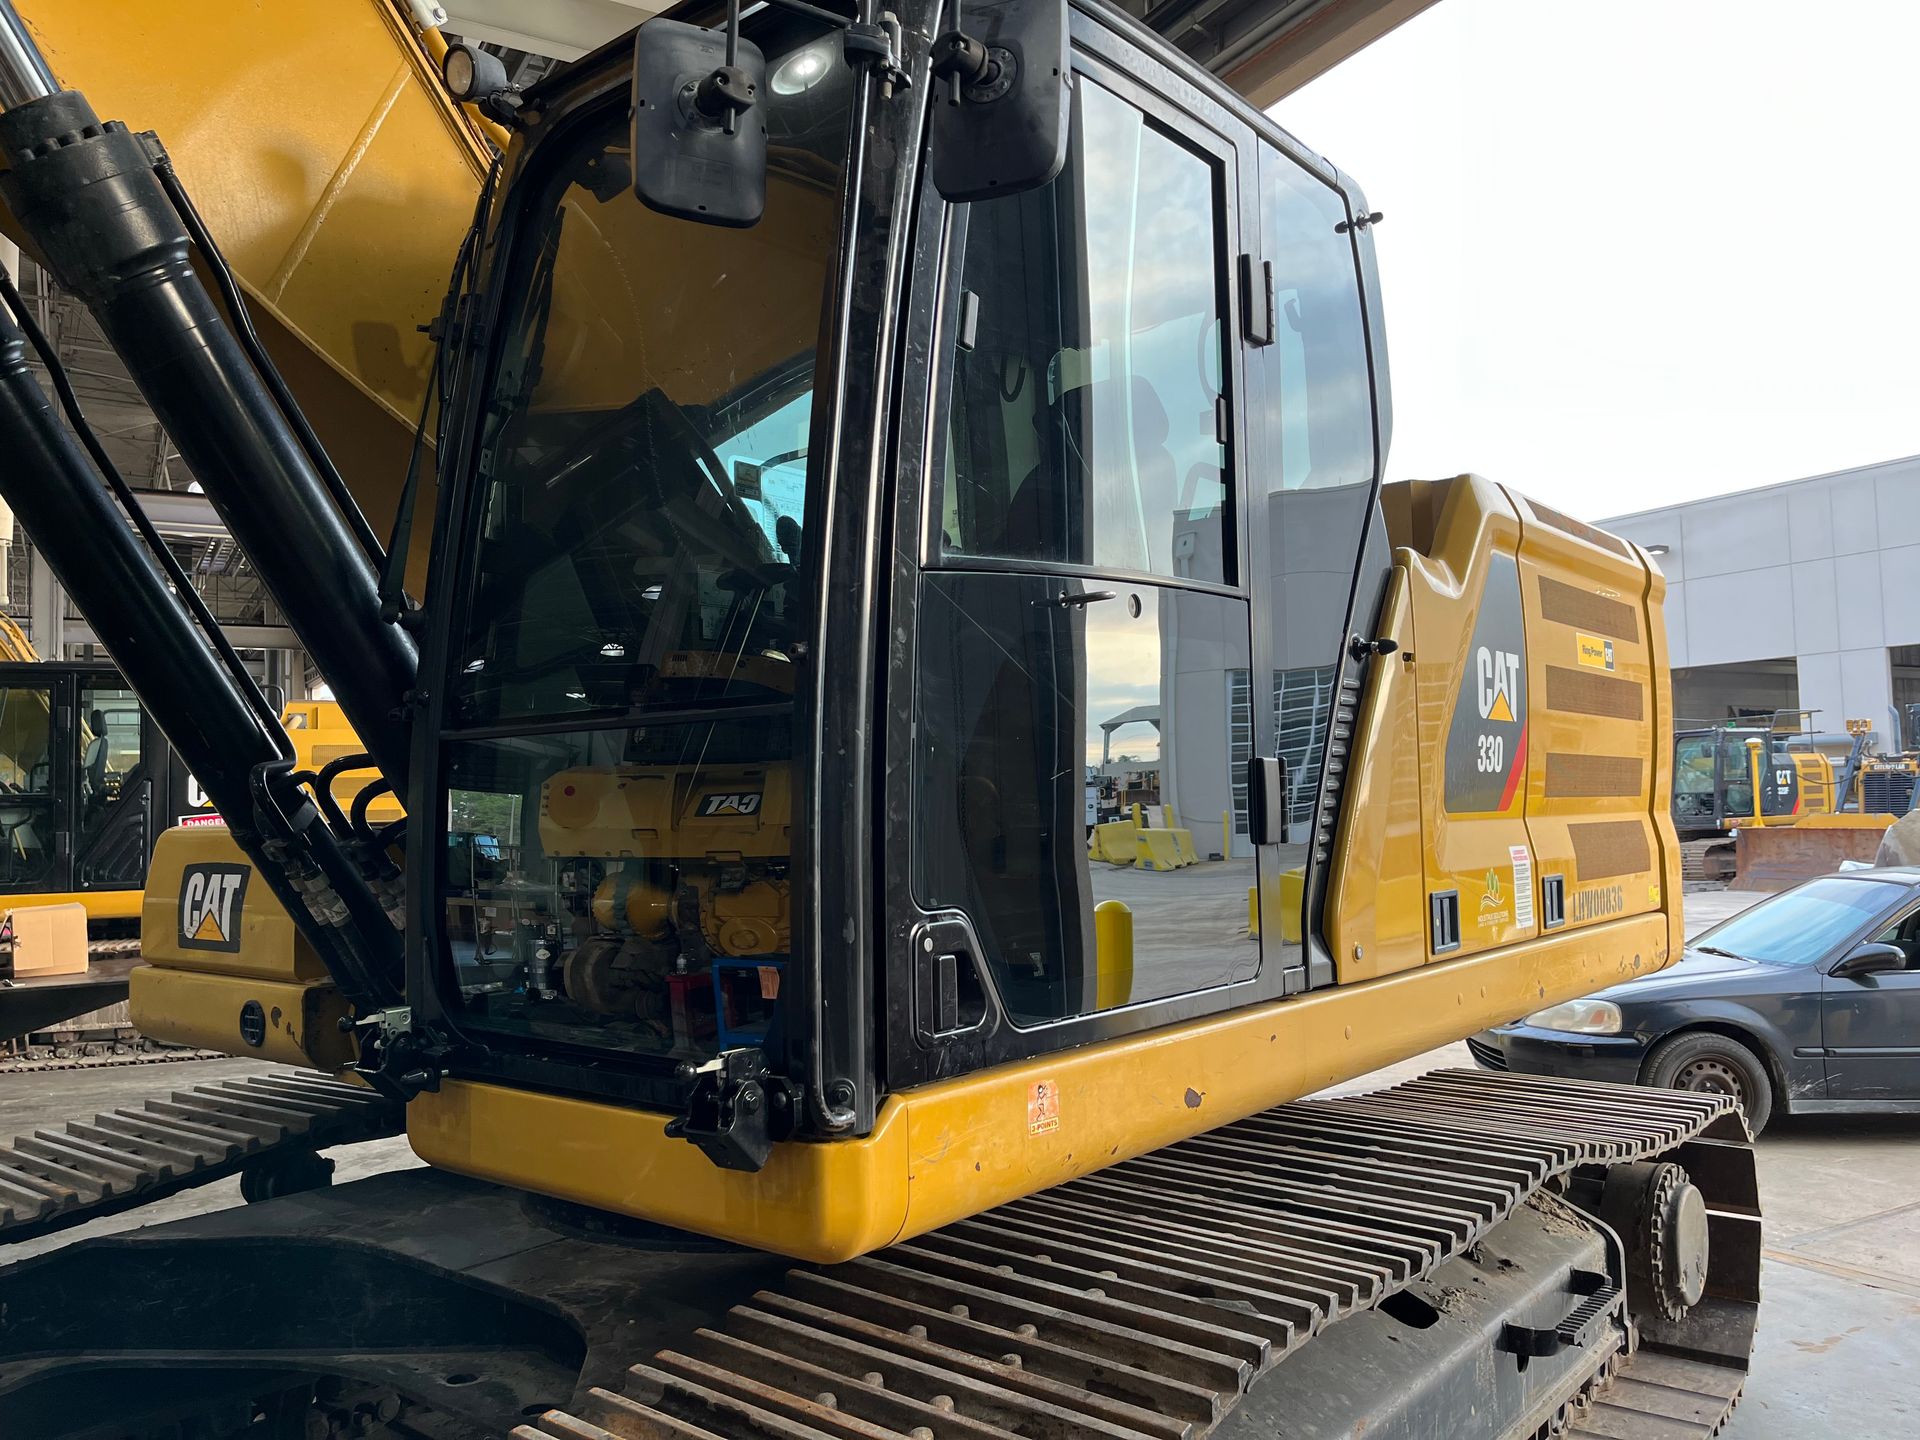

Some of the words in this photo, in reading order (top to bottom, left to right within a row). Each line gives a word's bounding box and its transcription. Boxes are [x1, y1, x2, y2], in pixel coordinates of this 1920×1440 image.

[1477, 646, 1519, 722] CAT
[1477, 735, 1503, 773] 330
[1776, 770, 1791, 785] CAT
[184, 873, 242, 942] CAT
[1573, 885, 1623, 922] LHW00836
